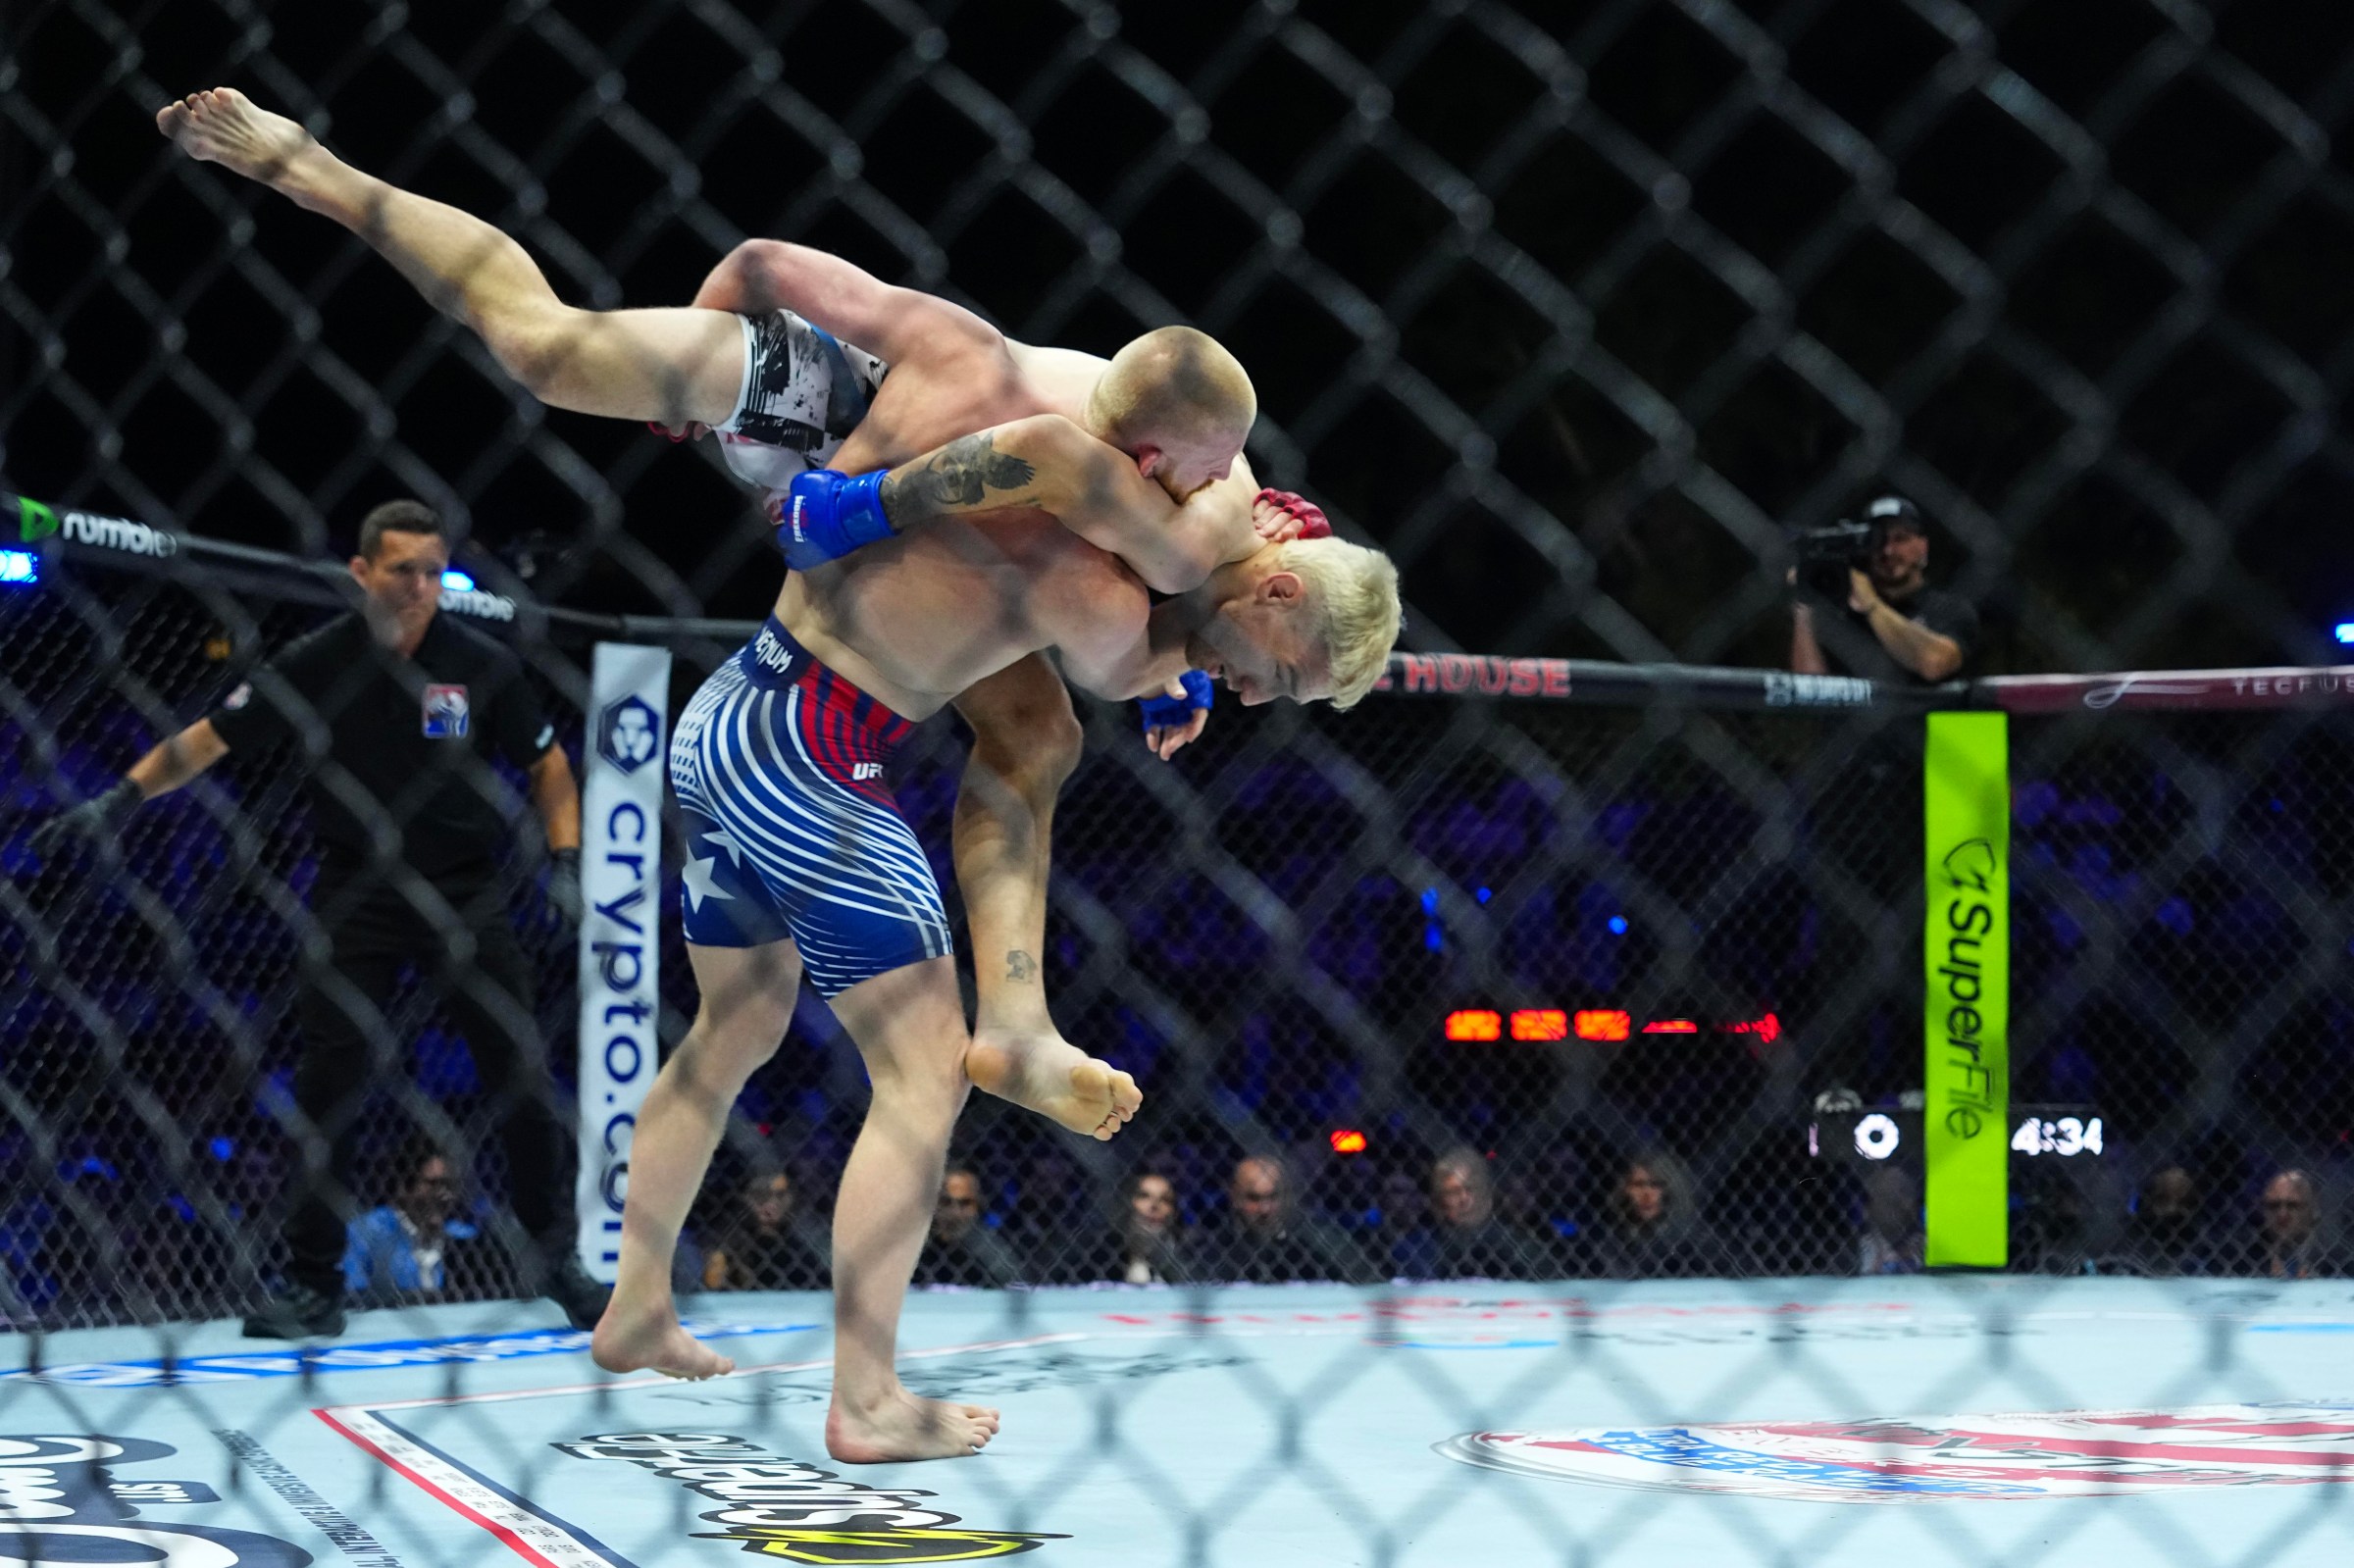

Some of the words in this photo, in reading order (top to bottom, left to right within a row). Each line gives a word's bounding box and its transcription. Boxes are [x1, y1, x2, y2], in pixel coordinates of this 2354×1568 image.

[63, 512, 177, 559] rumble
[437, 588, 516, 623] umble
[754, 626, 793, 675] VENUM
[1403, 653, 1572, 697] HOUSE
[1938, 898, 1993, 1140] SuperFile
[2011, 1117, 2103, 1156] 4:34
[1604, 1442, 1736, 1467] BLUE
[1720, 1467, 1904, 1489] RAZZ
[1698, 1450, 1823, 1470] RED
[1825, 1470, 2035, 1492] WHITE
[261, 1475, 331, 1506] IMMERSIVE
[300, 1511, 389, 1555] INTERACTIVE
